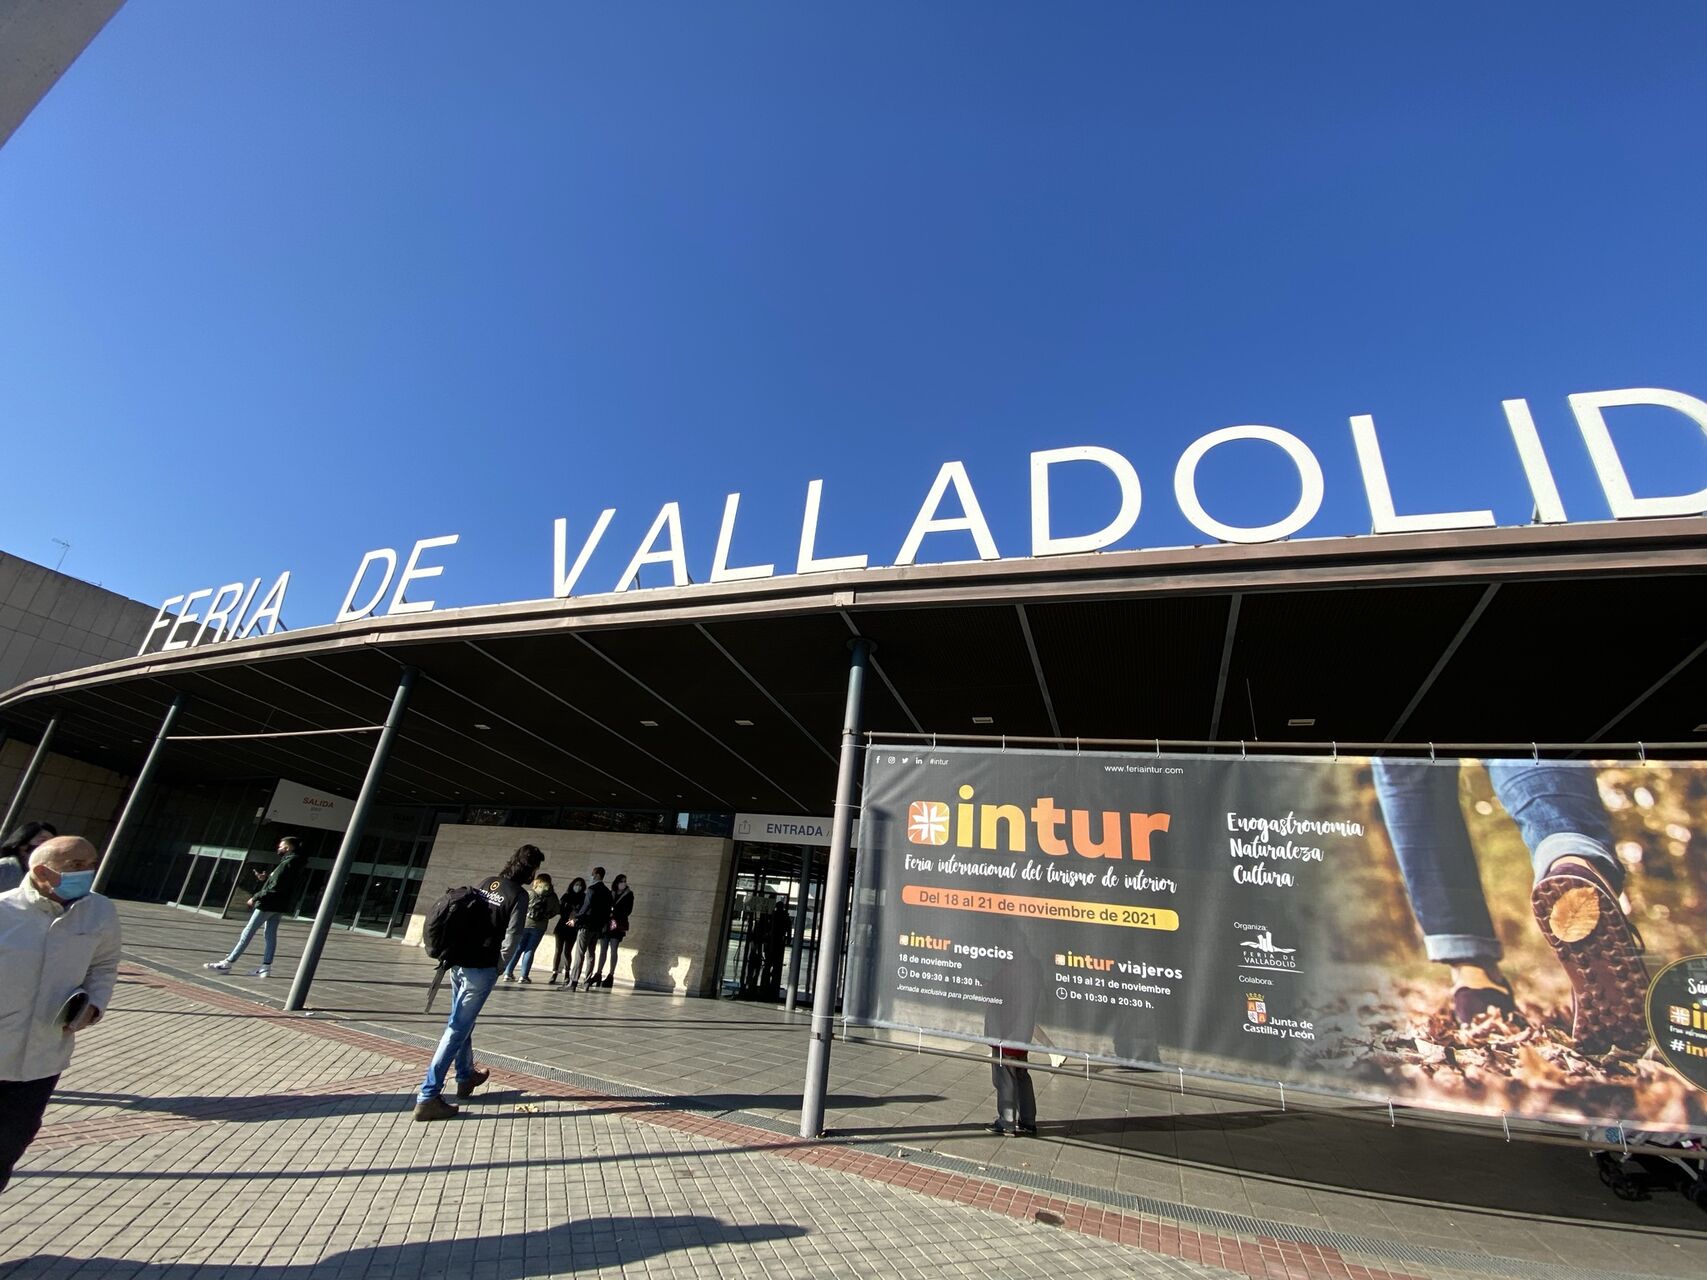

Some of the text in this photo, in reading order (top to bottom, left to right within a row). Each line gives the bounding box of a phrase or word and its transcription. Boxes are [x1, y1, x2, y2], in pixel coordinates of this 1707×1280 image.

[138, 388, 1707, 656] FERIA DE VALLADOLID
[1104, 765, 1184, 774] www.feriaintur.com
[302, 797, 334, 809] SALIDA
[766, 823, 823, 836] ENTRADA
[956, 784, 1171, 861] intur
[1229, 835, 1324, 862] Naturaleza
[904, 853, 1178, 894] Feria internacional del turismo de interior
[1233, 862, 1295, 887] Cultura
[919, 890, 1156, 926] Del 18 al 21 de noviembre de 2021
[910, 931, 1014, 960] intur negocios
[1243, 951, 1275, 960] FERIA
[899, 953, 962, 969] 18 de noviembre
[1067, 950, 1183, 979] intur viajeros
[1244, 957, 1296, 968] VALLADOLID
[910, 970, 920, 978] De
[922, 972, 943, 981] 09:30
[952, 976, 973, 986] 18:30
[975, 979, 983, 987] h.
[1055, 973, 1171, 995] Del 19 al 21 de noviembre
[897, 983, 1003, 1005] Jornada exclusiva para profesionales
[1070, 991, 1154, 1009] De 10:30 a 20:30 h.
[1243, 1023, 1315, 1040] Castilla y León
[1269, 1017, 1314, 1030] Junta de
